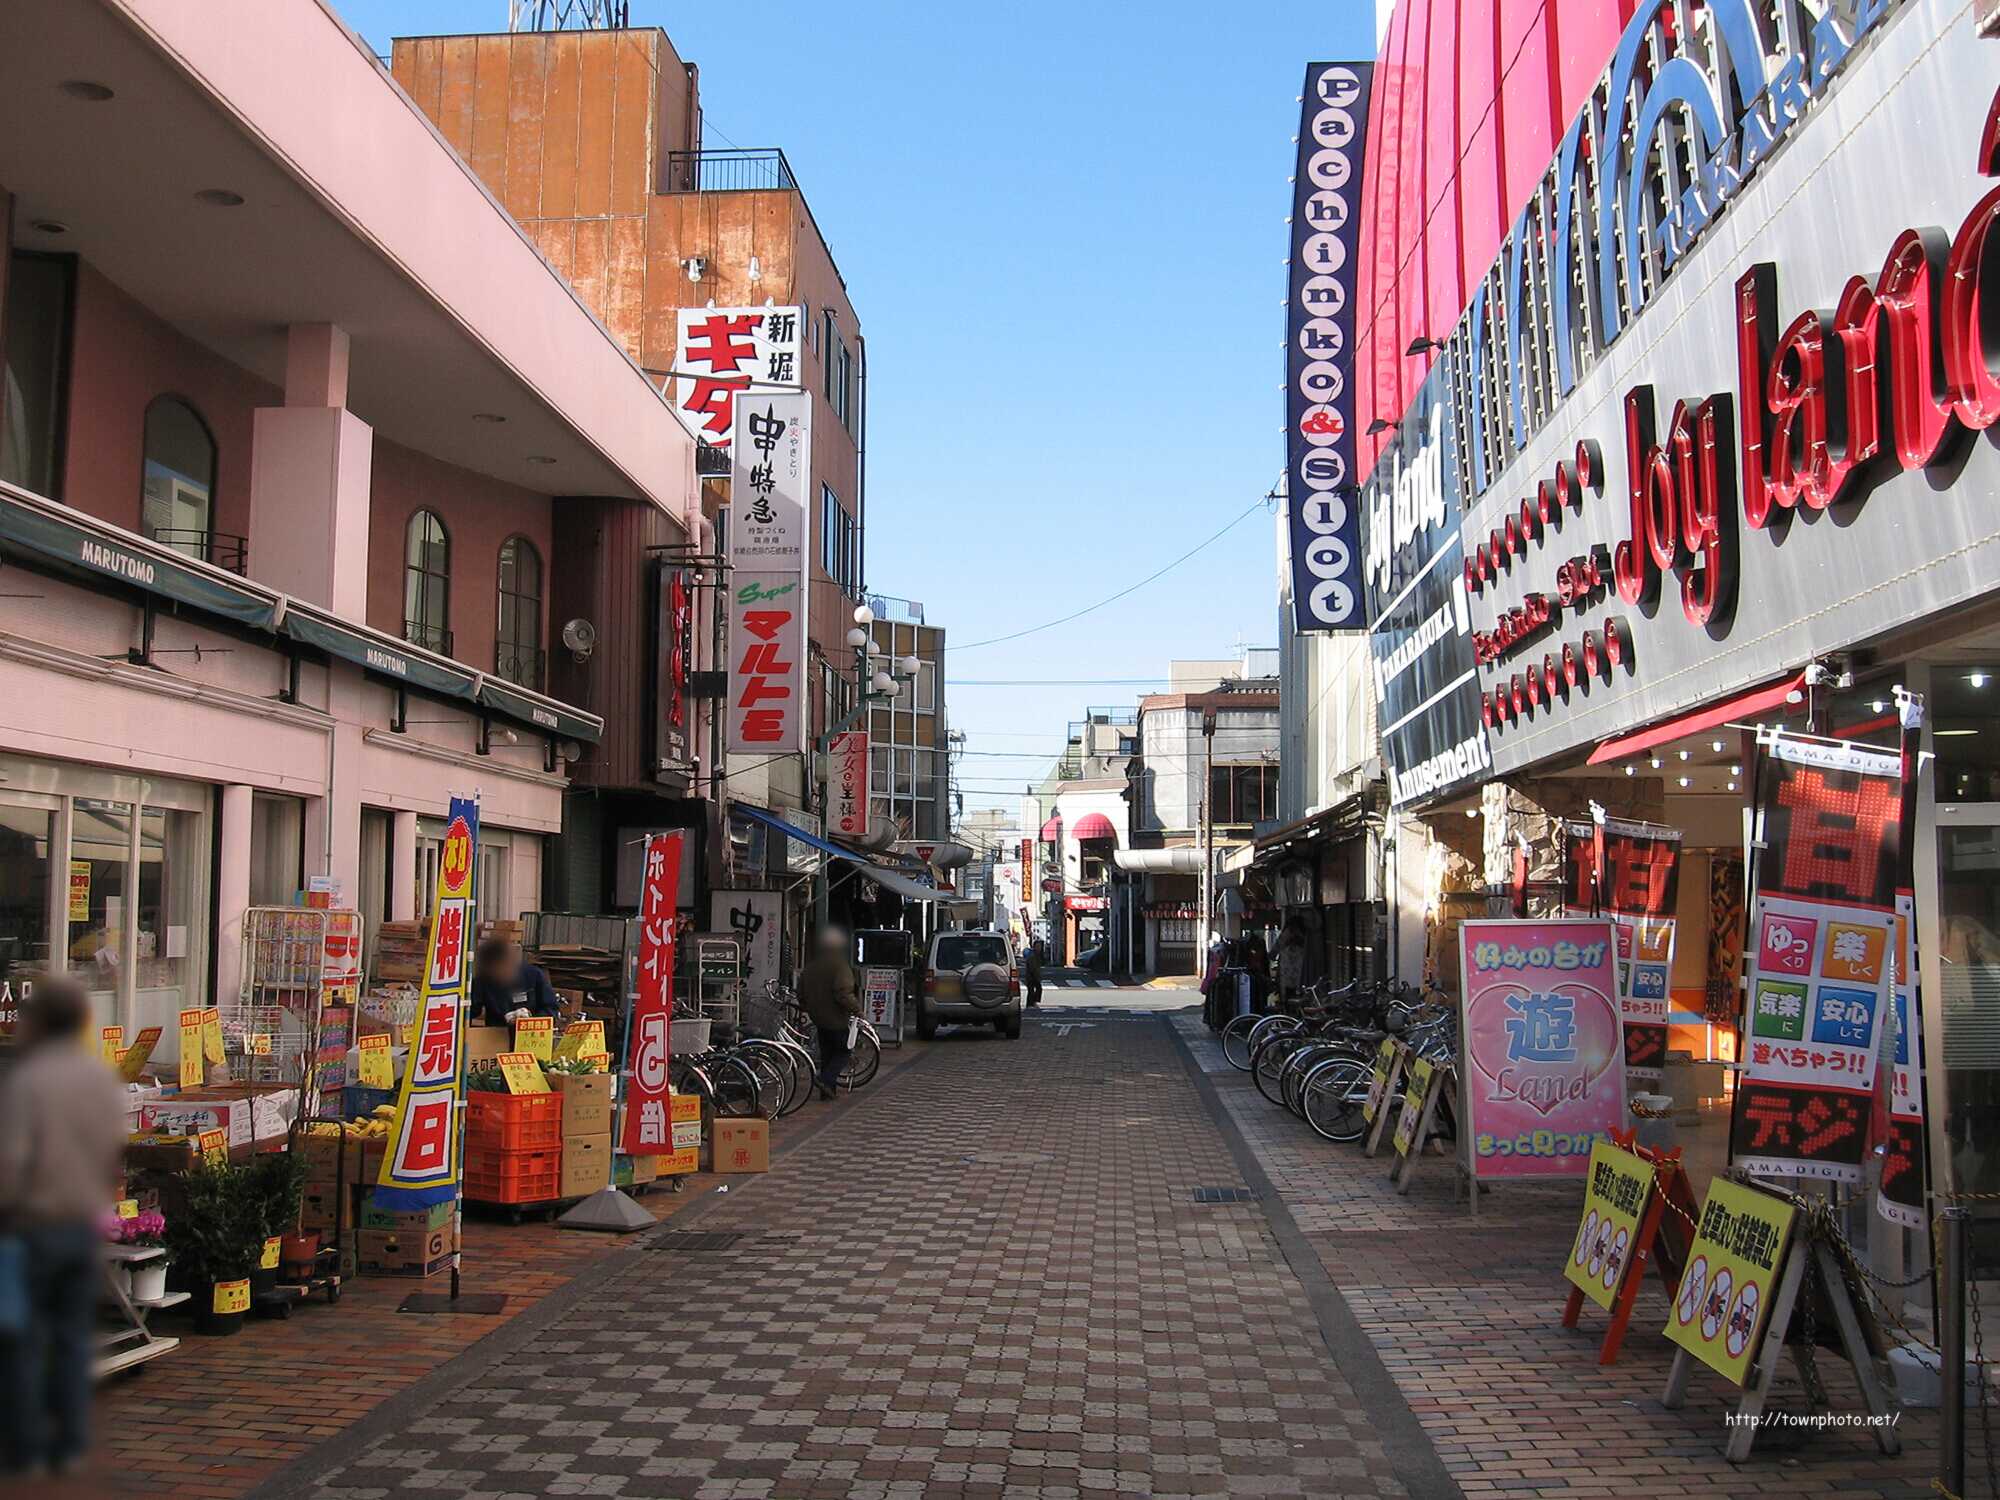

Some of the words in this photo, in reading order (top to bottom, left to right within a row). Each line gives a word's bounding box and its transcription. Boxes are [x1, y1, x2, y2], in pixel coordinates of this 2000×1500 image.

[1303, 76, 1361, 393] Pachinko
[768, 313, 796, 382] 新堀
[1301, 410, 1344, 435] &
[745, 402, 786, 524] 串特急
[1393, 402, 1447, 553] land
[1305, 457, 1344, 614] Slot
[82, 541, 154, 585] MARUTOMO
[737, 583, 797, 605] Super
[367, 649, 407, 676] MARUTOMO
[1382, 602, 1455, 686] TAKARAZUKA
[738, 611, 792, 742] マルトモ
[532, 708, 559, 729] MARUTOMO
[1389, 718, 1493, 807] Amusement
[1778, 770, 1903, 897] 甘
[1475, 940, 1606, 971] 好みの台が
[1505, 992, 1578, 1064] 遊
[1757, 990, 1803, 1019] 気楽
[1820, 999, 1870, 1026] 安心
[1752, 1043, 1867, 1075] 遊べちゃう!!
[1839, 1026, 1865, 1040] して
[1488, 1064, 1592, 1103] Land
[1745, 1096, 1858, 1156] デジ
[1749, 1163, 1844, 1178] AMA-DIGI
[1700, 1199, 1780, 1272] 駐車及び駐輪禁止
